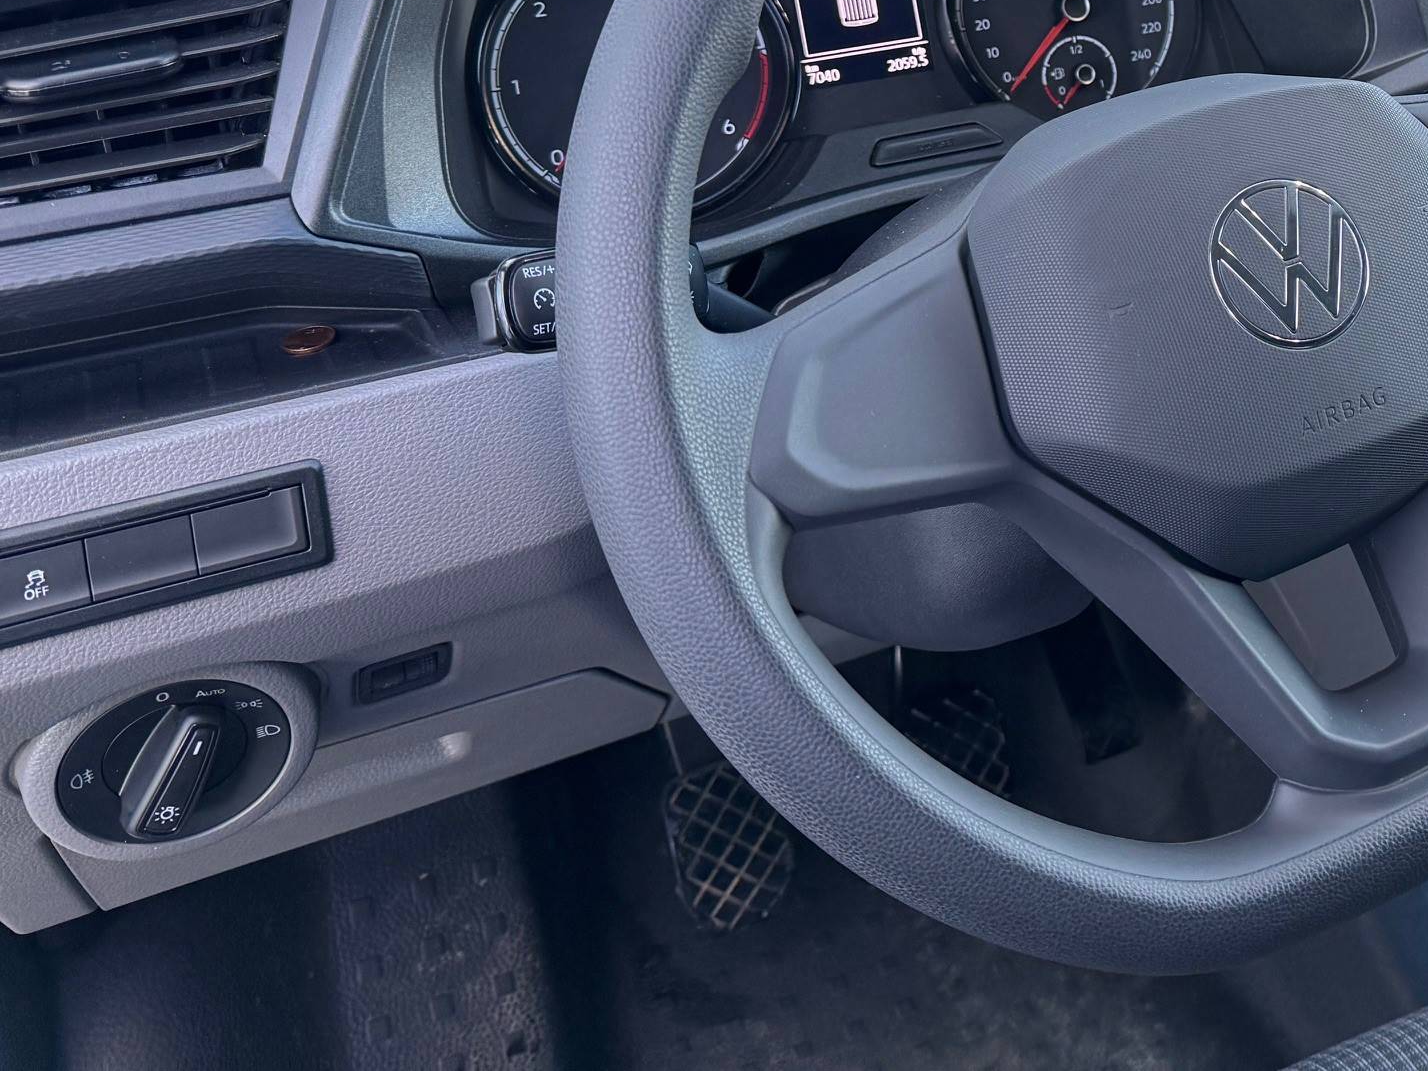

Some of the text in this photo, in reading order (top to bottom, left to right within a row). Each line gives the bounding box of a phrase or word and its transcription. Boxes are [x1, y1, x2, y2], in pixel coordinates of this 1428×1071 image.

[533, 1, 547, 18] 2
[975, 19, 991, 32] 20
[1141, 21, 1162, 34] 220
[986, 47, 1000, 59] 10
[1131, 49, 1152, 61] 240
[886, 55, 929, 72] 2059.5
[806, 68, 841, 85] 7040
[1002, 72, 1012, 83] 0
[510, 80, 521, 96] 1
[722, 118, 736, 135] 6
[550, 149, 565, 167] 0
[1301, 386, 1388, 437] AIRBAG
[24, 585, 50, 601] OFF
